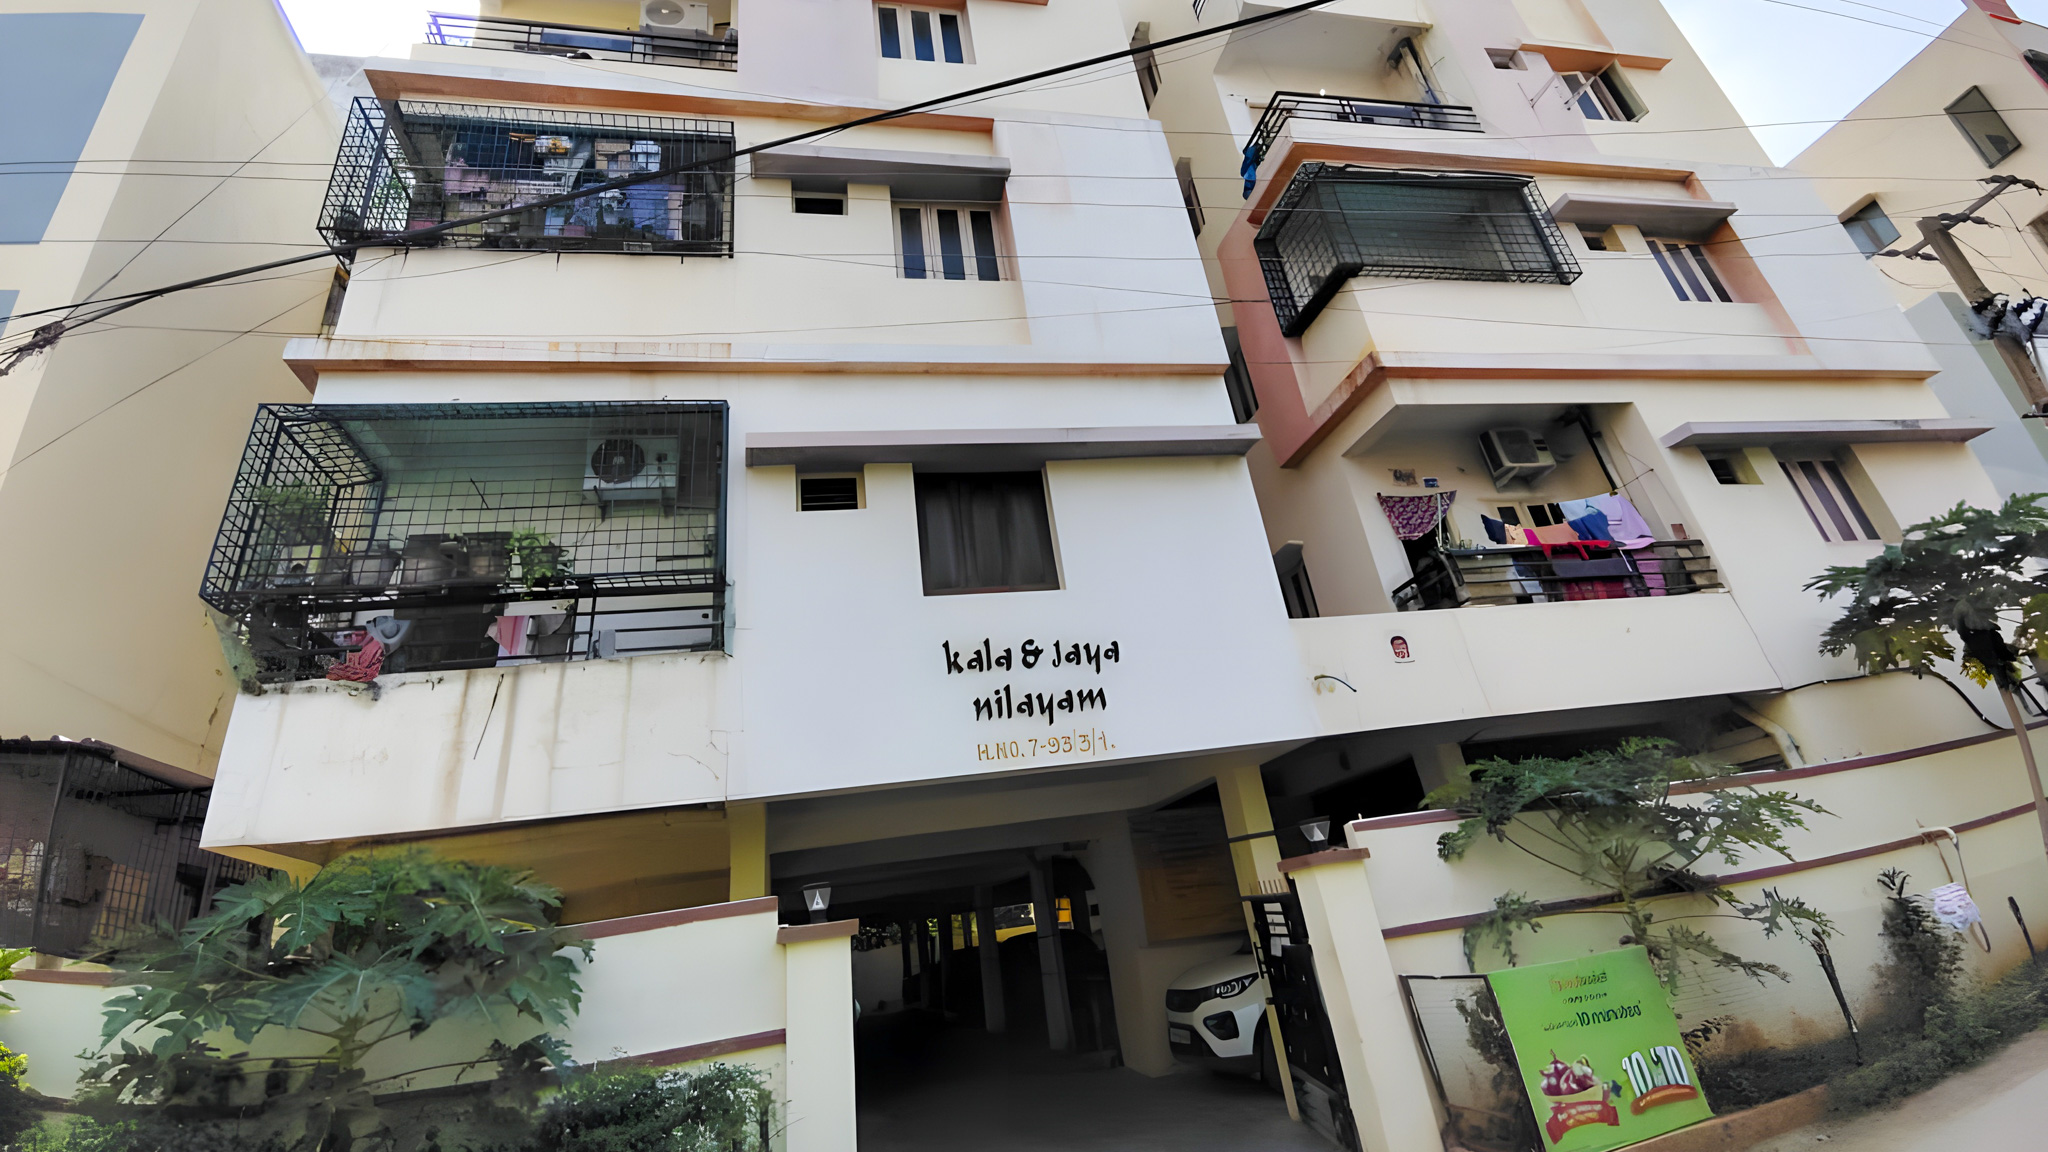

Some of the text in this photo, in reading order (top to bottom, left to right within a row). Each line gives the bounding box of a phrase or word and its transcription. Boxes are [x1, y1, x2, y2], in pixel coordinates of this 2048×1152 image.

[942, 638, 1012, 674] kala
[1021, 639, 1043, 669] &
[973, 684, 1107, 726] nilayam
